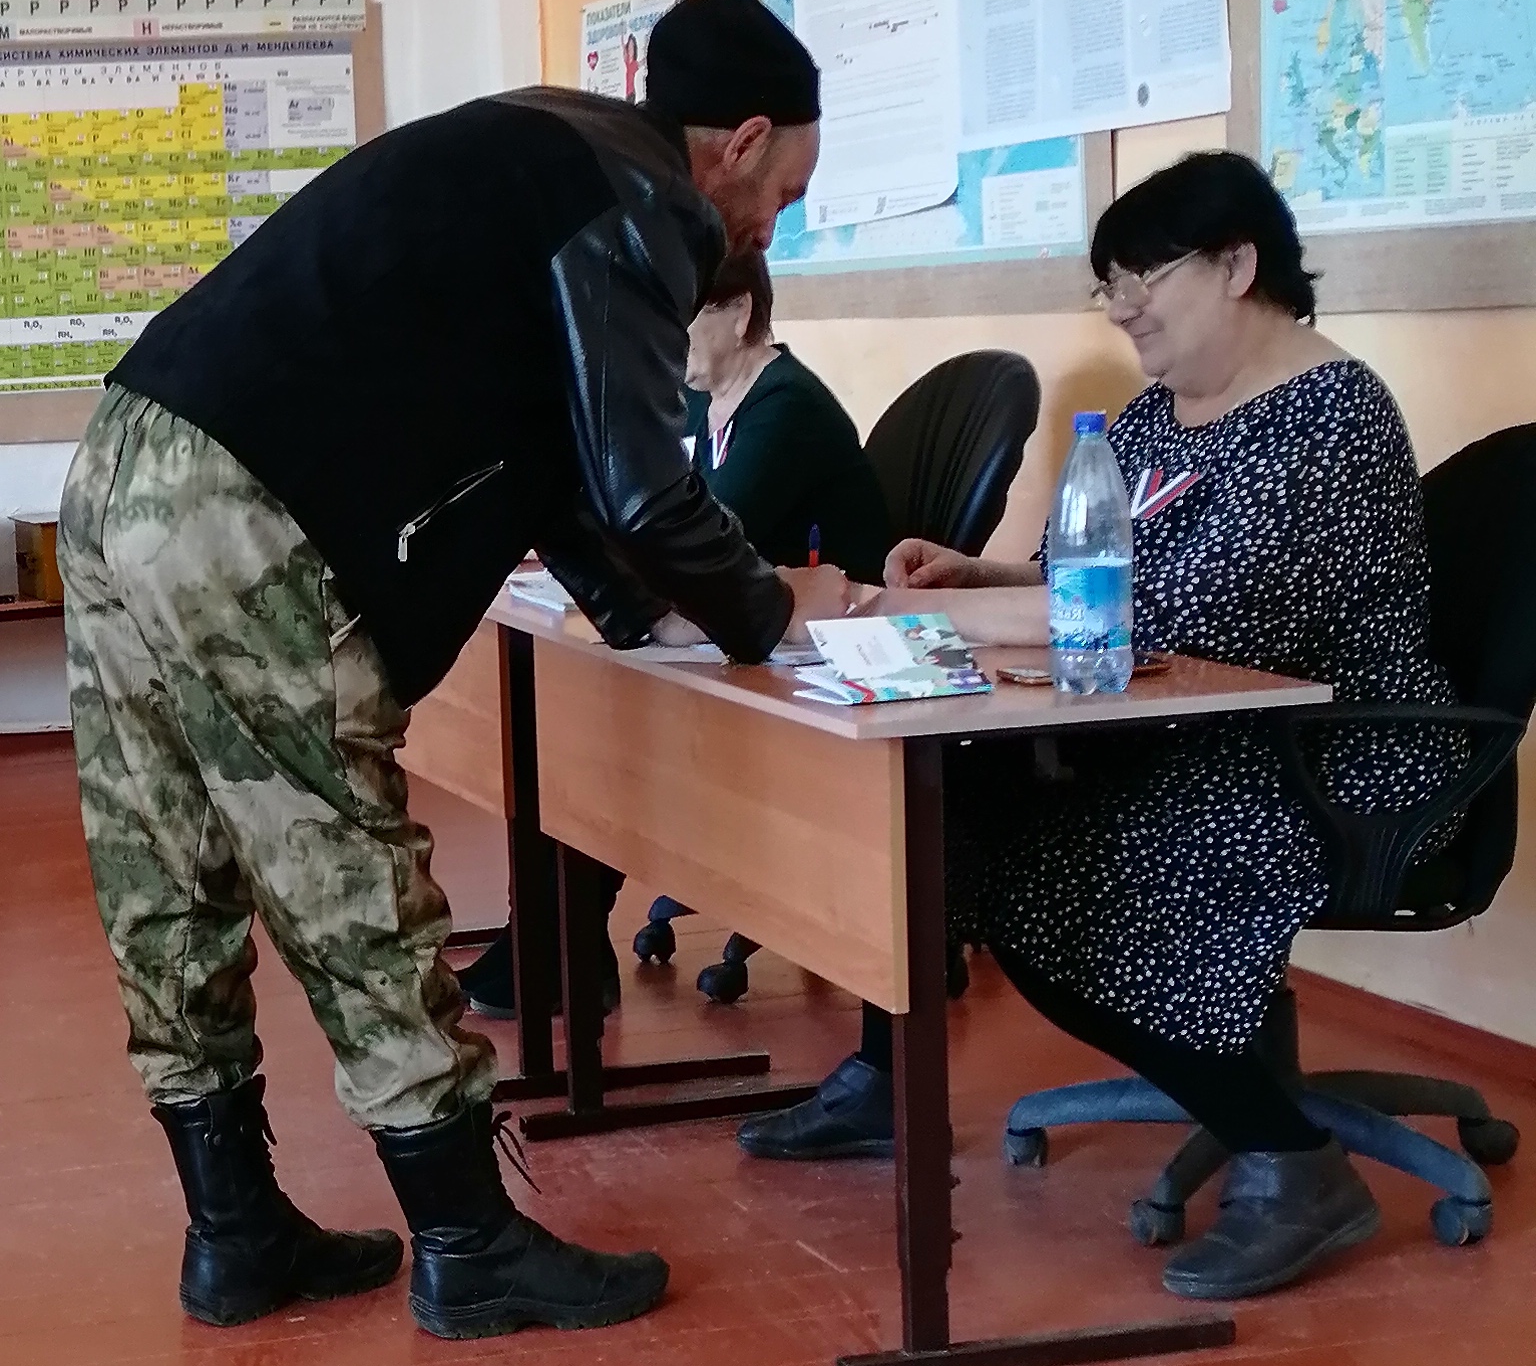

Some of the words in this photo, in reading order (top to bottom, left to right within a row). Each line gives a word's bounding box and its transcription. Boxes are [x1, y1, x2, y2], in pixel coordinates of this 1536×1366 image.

[59, 46, 139, 60] ХИМИЧЕСКИХ
[146, 44, 218, 57] ЭЛЕМЕНТОВ
[257, 40, 334, 52] МЕНДЕЛЕЕВА
